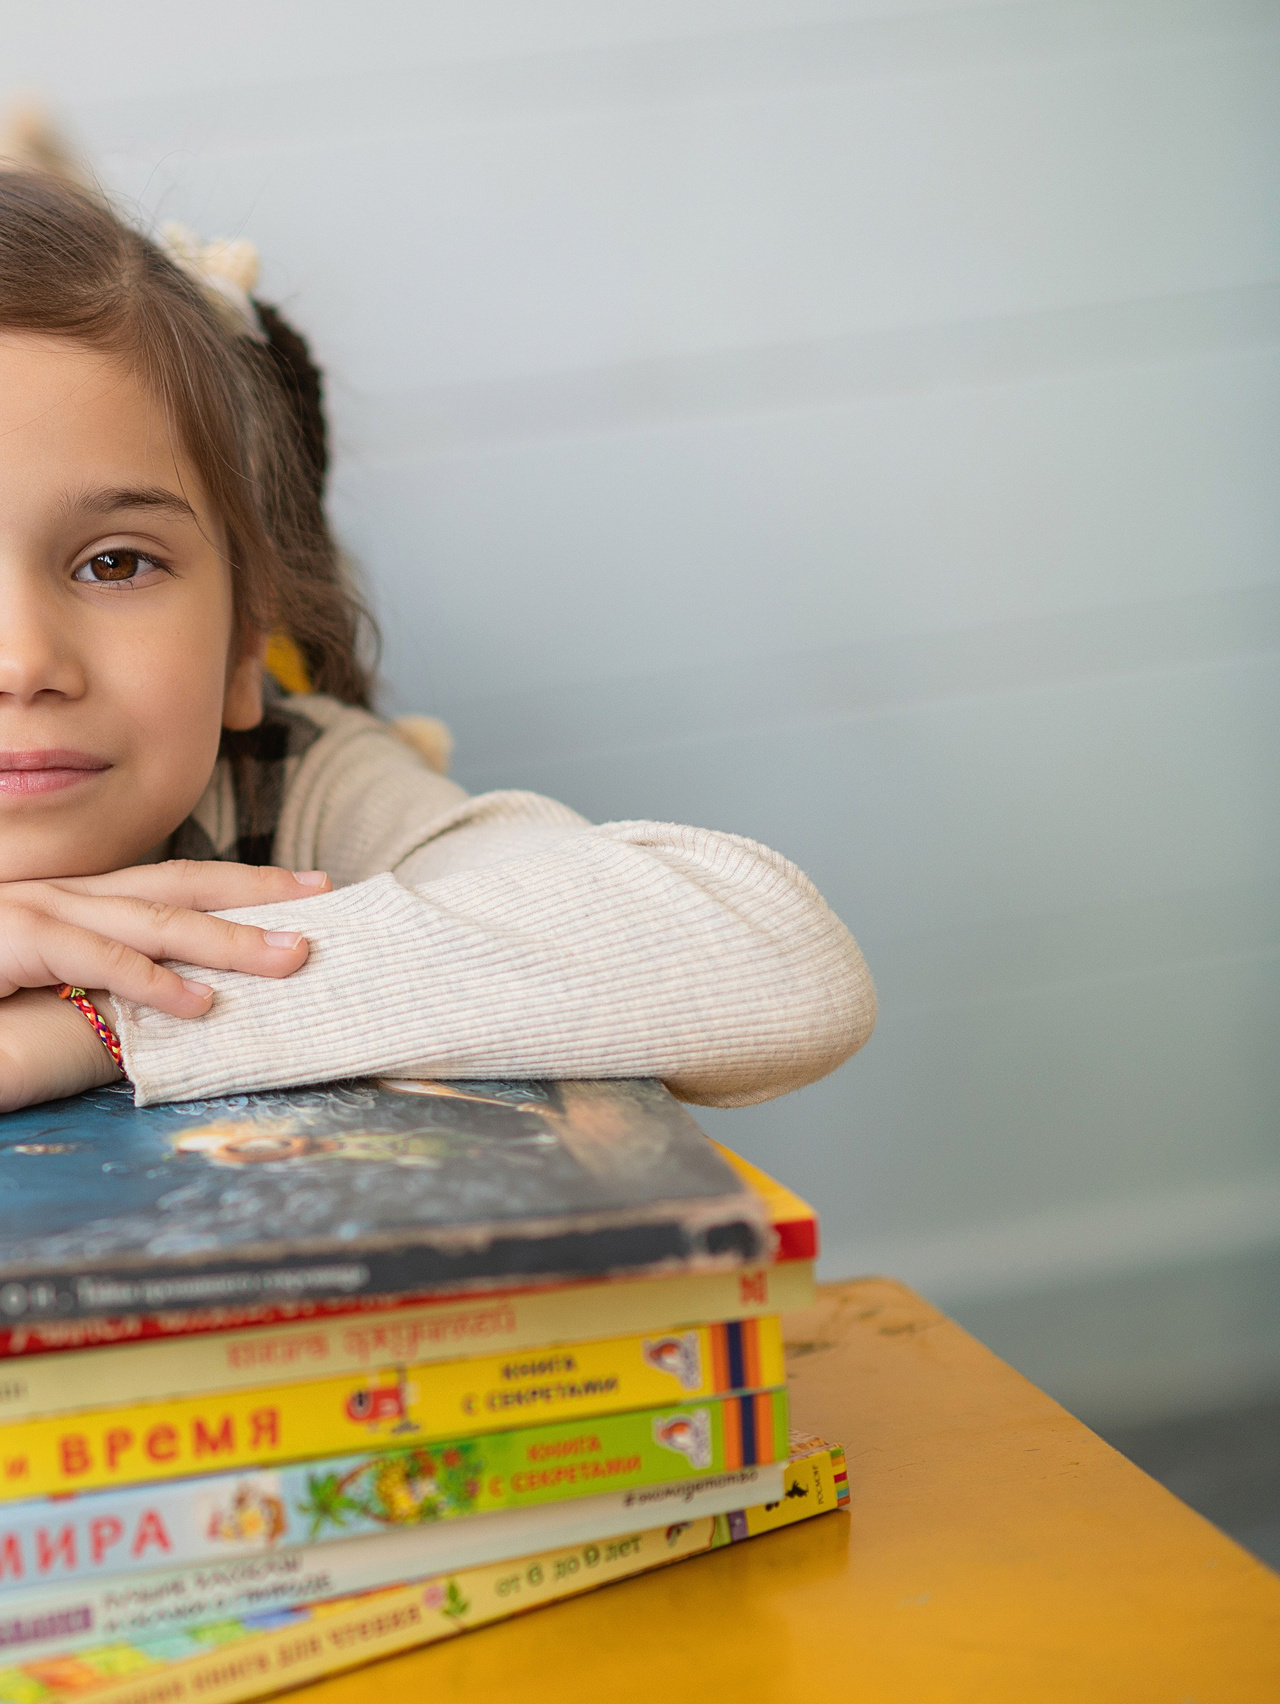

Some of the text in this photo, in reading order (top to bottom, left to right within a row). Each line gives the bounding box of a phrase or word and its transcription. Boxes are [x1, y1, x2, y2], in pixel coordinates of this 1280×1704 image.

[502, 1355, 576, 1381] КНИГА
[485, 1375, 618, 1412] СЕКРЕТАМИ
[527, 1435, 602, 1462] КНИГА
[4, 1455, 28, 1480] и
[511, 1455, 643, 1493] СЕКРЕТАМИ
[494, 1537, 642, 1597] от 6 до 9 лет
